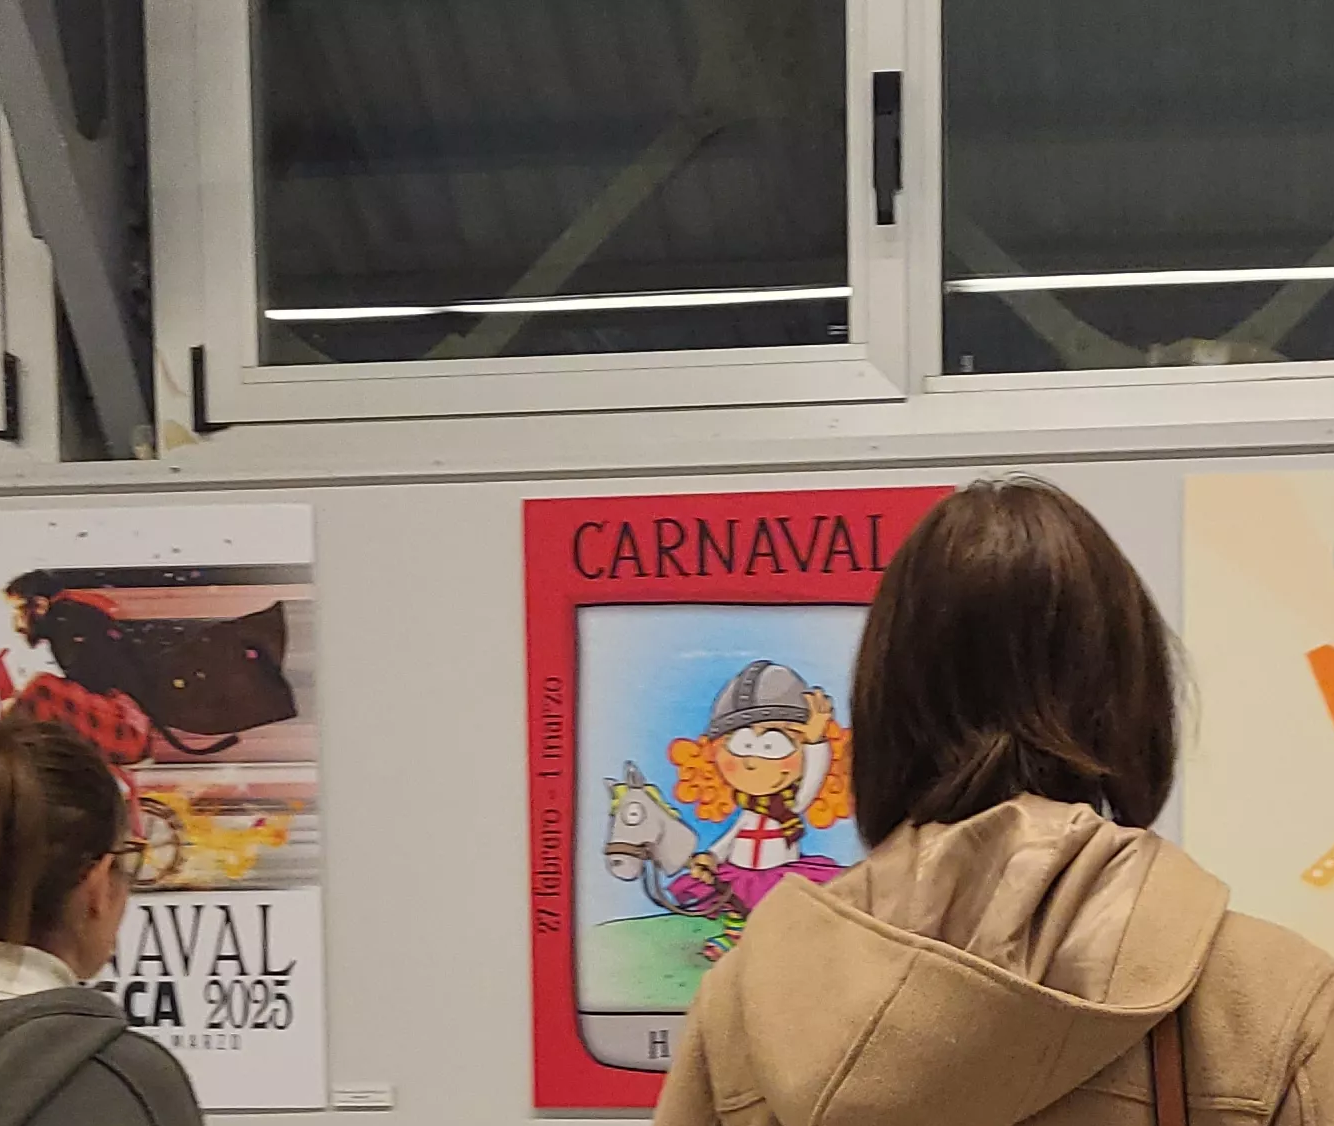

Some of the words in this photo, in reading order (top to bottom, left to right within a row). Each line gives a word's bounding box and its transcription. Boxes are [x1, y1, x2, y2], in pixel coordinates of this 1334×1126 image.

[572, 514, 887, 580] CARNAVAL
[112, 904, 297, 977] AVAL
[203, 980, 295, 1030] 2025
